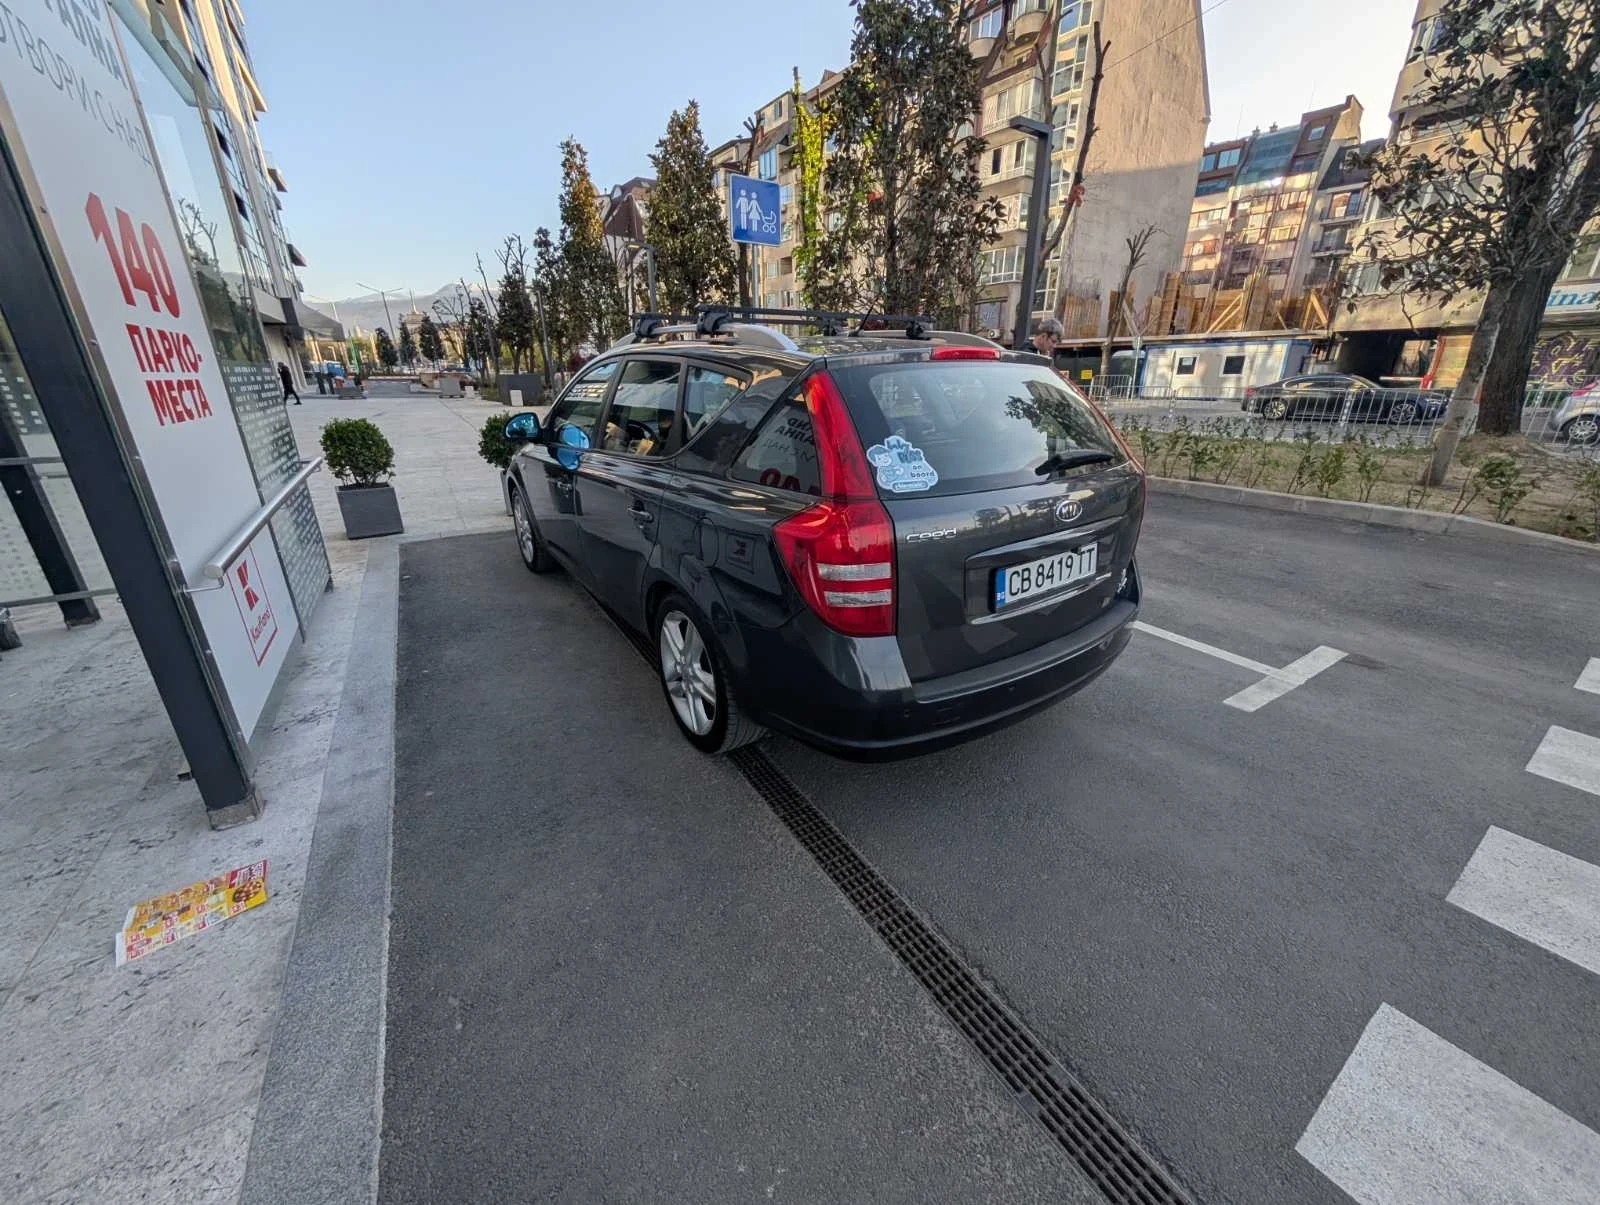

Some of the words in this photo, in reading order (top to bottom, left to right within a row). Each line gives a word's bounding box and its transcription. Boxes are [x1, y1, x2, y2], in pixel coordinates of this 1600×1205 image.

[85, 191, 180, 319] 140
[125, 323, 203, 374] ПАРКО-
[145, 379, 213, 426] МЕСТА
[910, 470, 935, 478] board
[1009, 569, 1032, 597] CB
[1035, 555, 1073, 587] 8419
